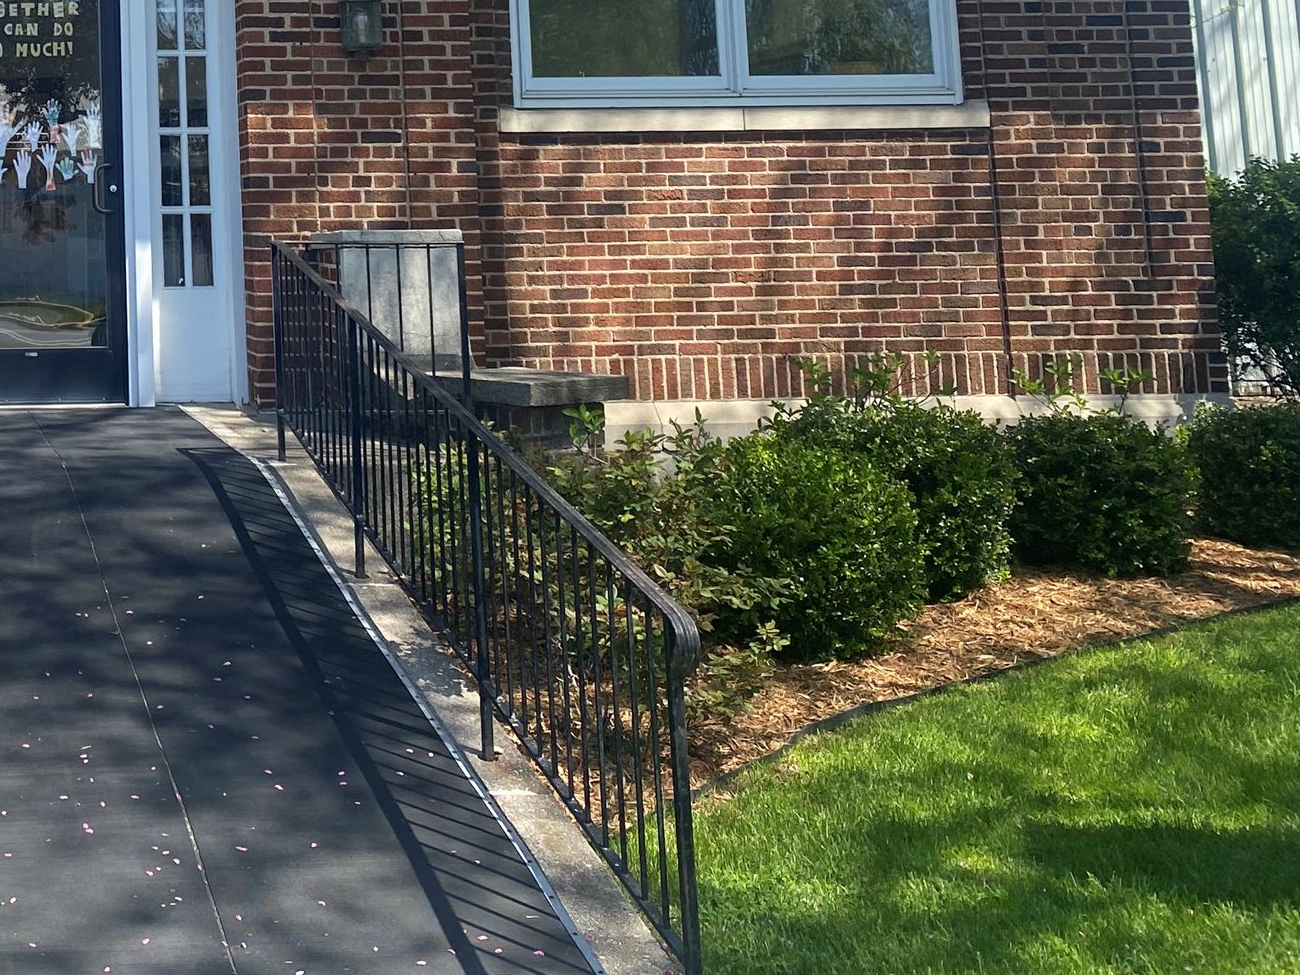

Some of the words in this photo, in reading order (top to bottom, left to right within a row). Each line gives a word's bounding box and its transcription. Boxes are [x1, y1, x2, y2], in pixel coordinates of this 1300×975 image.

[3, 23, 38, 36] CAN
[53, 22, 74, 36] DO
[16, 41, 73, 58] MUCH!
